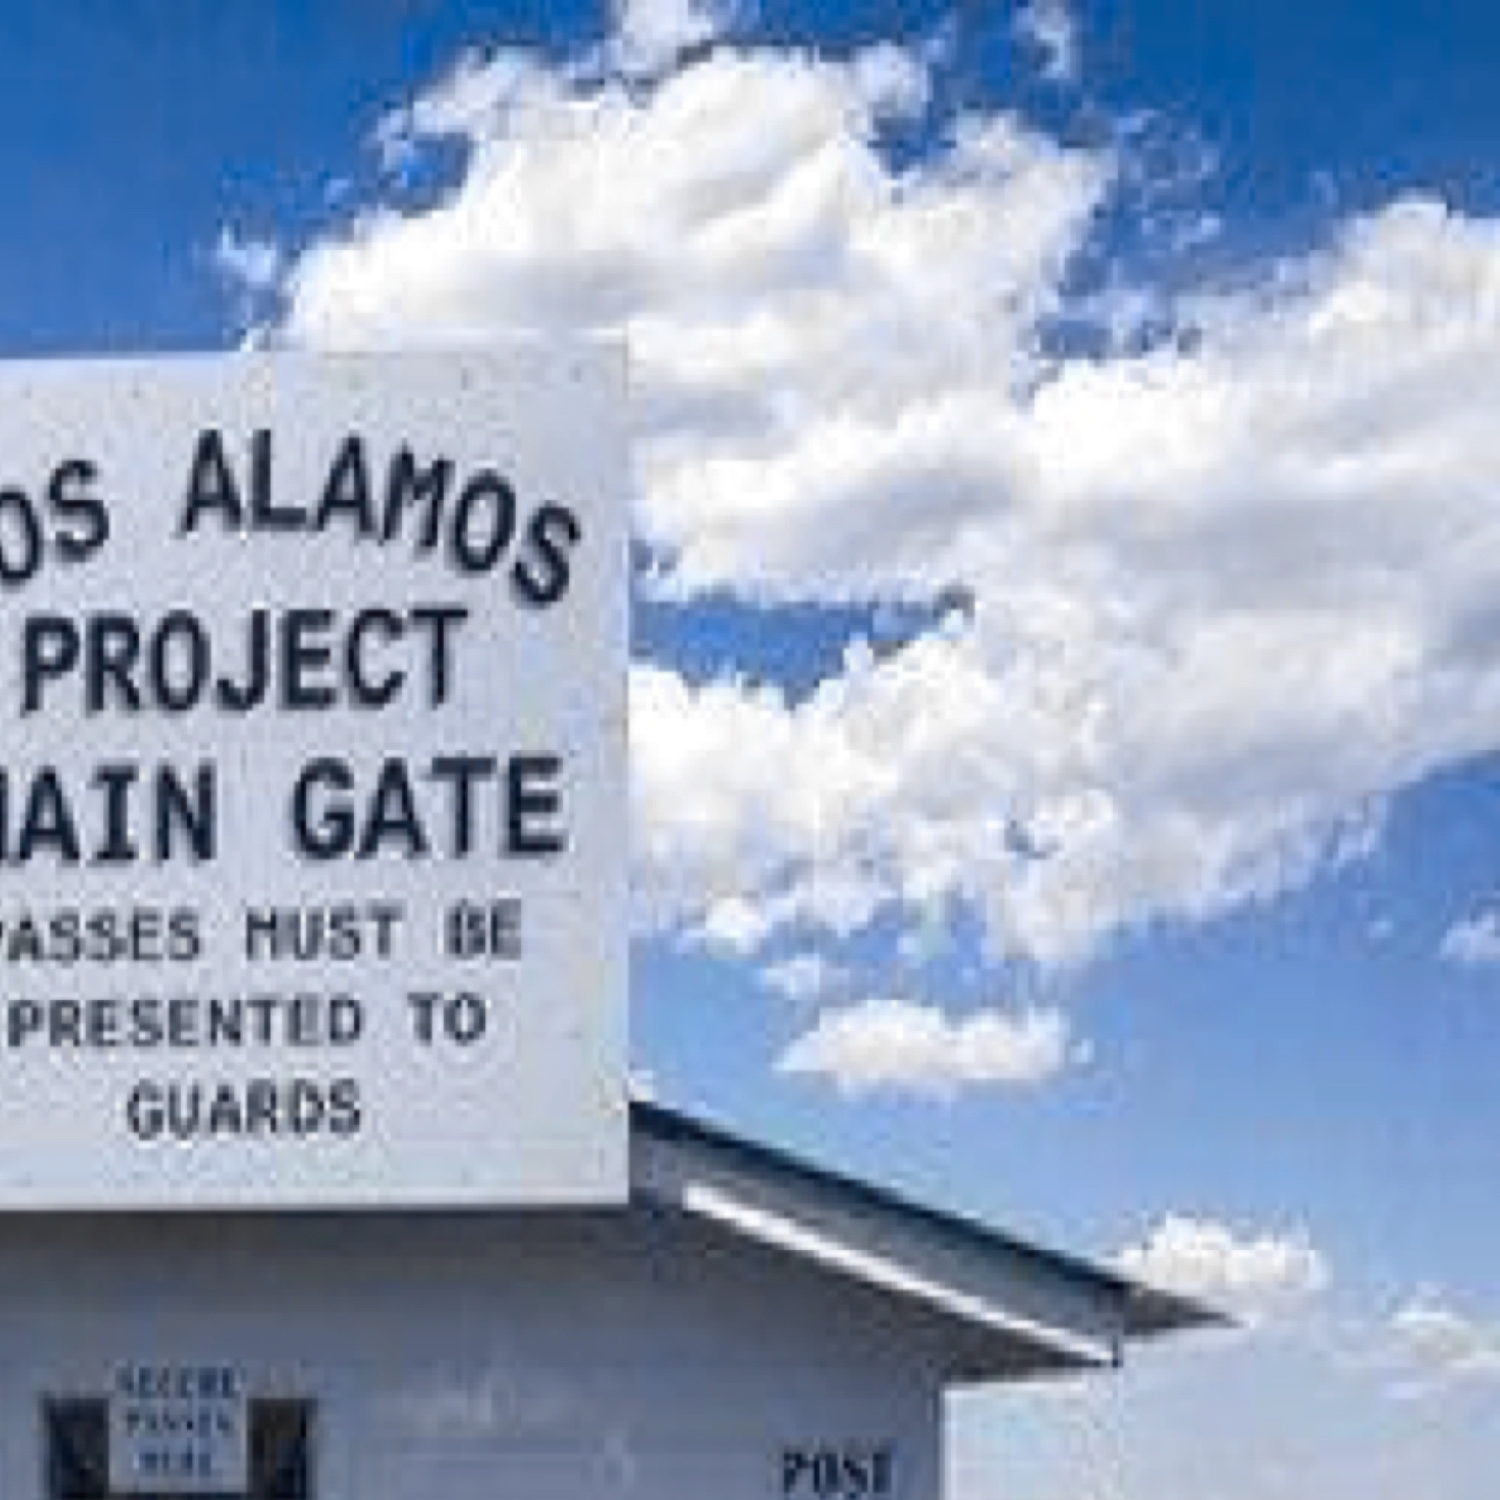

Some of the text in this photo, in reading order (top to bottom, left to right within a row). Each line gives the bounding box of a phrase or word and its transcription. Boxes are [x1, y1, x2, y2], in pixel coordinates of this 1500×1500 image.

[180, 427, 582, 607] ALAMOS
[20, 606, 469, 714] PROJECT
[293, 755, 563, 860] GATE
[245, 905, 402, 960] MUST
[446, 898, 521, 960] BE
[8, 993, 487, 1047] PRESENTED TO
[126, 1078, 362, 1138] GUARDS
[782, 1452, 892, 1498] POST
